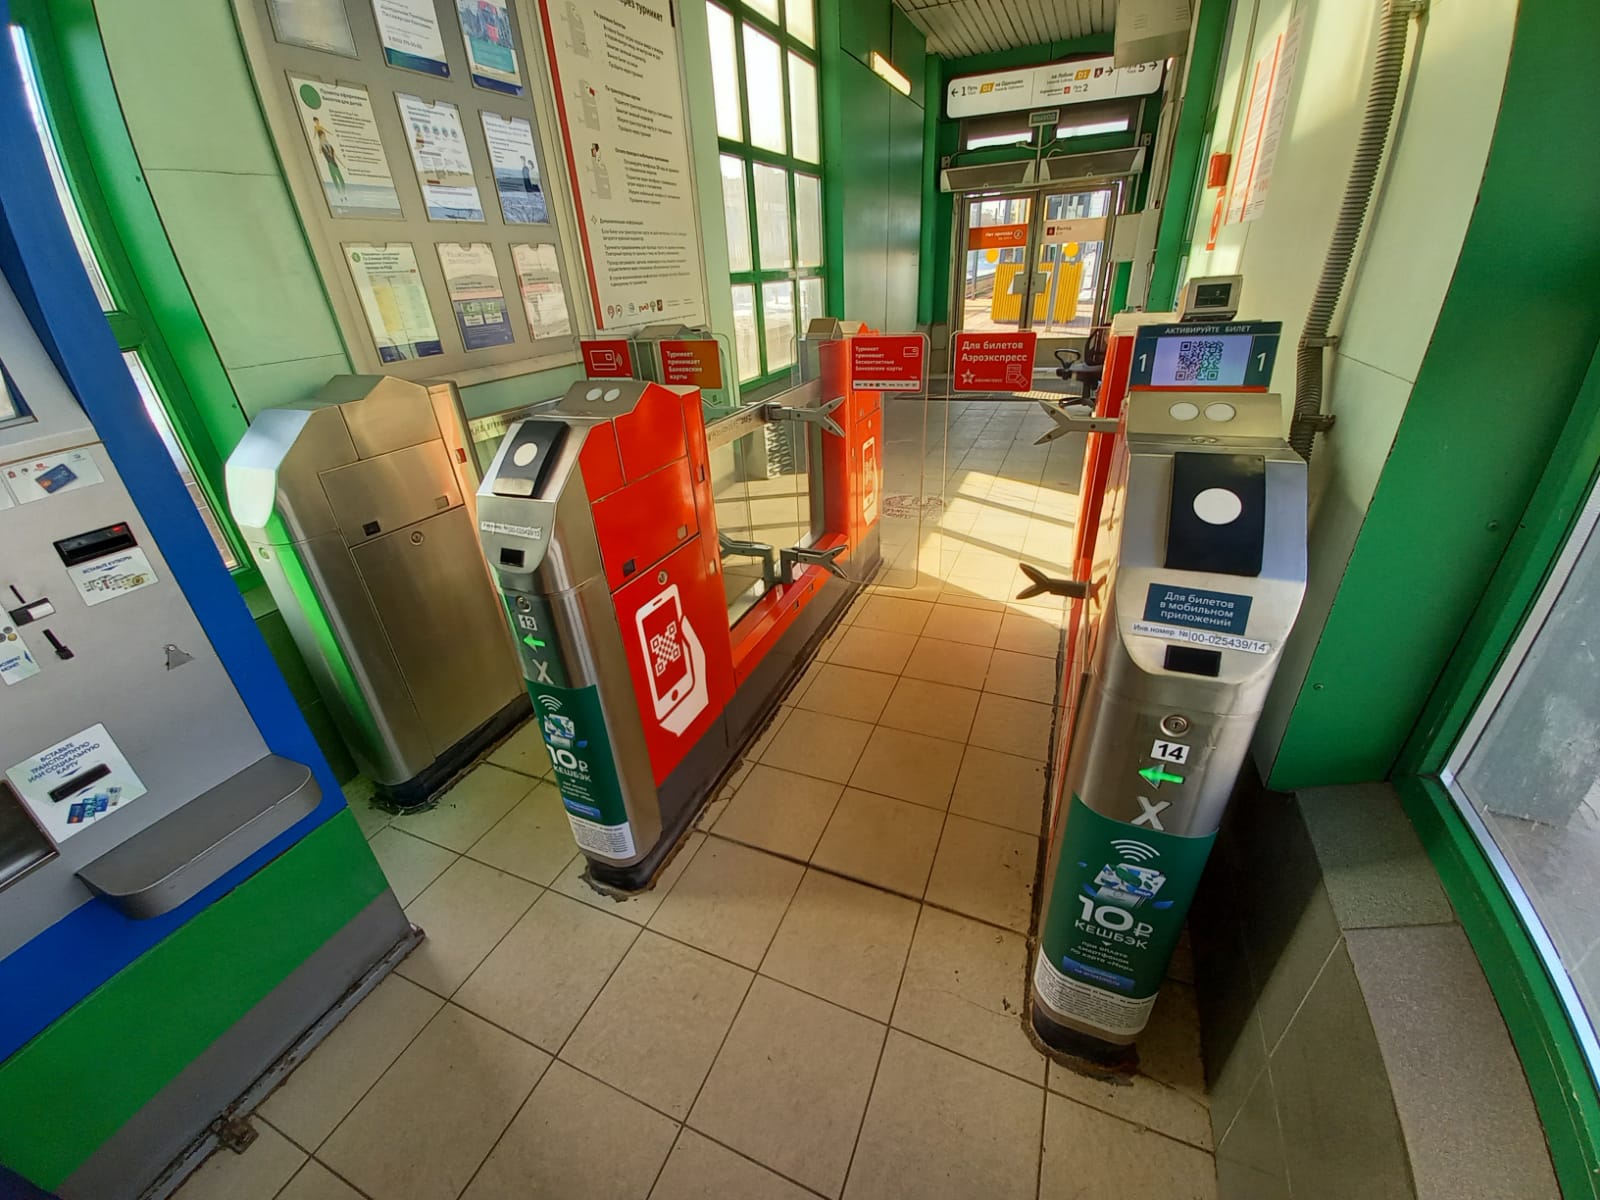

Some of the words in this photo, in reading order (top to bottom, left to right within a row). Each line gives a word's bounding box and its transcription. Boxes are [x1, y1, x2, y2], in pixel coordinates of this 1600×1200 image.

[961, 86, 967, 97] 1
[1082, 83, 1089, 92] 2
[1165, 326, 1219, 334] АКТИВИРУЙТЕ
[1225, 325, 1252, 333] БИЛЕТ
[961, 340, 981, 350] Для
[983, 340, 1023, 350] билетов
[666, 350, 693, 359] Турникет
[961, 352, 1028, 363] Аэроэкспресс
[1139, 353, 1147, 372] 1
[1257, 352, 1267, 372] 1
[1164, 591, 1186, 602] Для
[1187, 594, 1234, 609] билетов
[1168, 601, 1234, 618] мобильном
[521, 617, 535, 629] 13
[1160, 610, 1232, 627] приложении
[1191, 631, 1266, 652] 00-025439/14
[31, 742, 90, 774] ТРАНСПОРТНУЮ
[40, 742, 74, 762] ВСТАВЬТЕ
[1158, 743, 1184, 760] 14
[28, 771, 46, 783] ИЛИ
[45, 743, 100, 774] СОЦИАЛЬНУЮ
[56, 760, 78, 775] КАРТУ
[1074, 919, 1149, 950] КЕШБЭК
